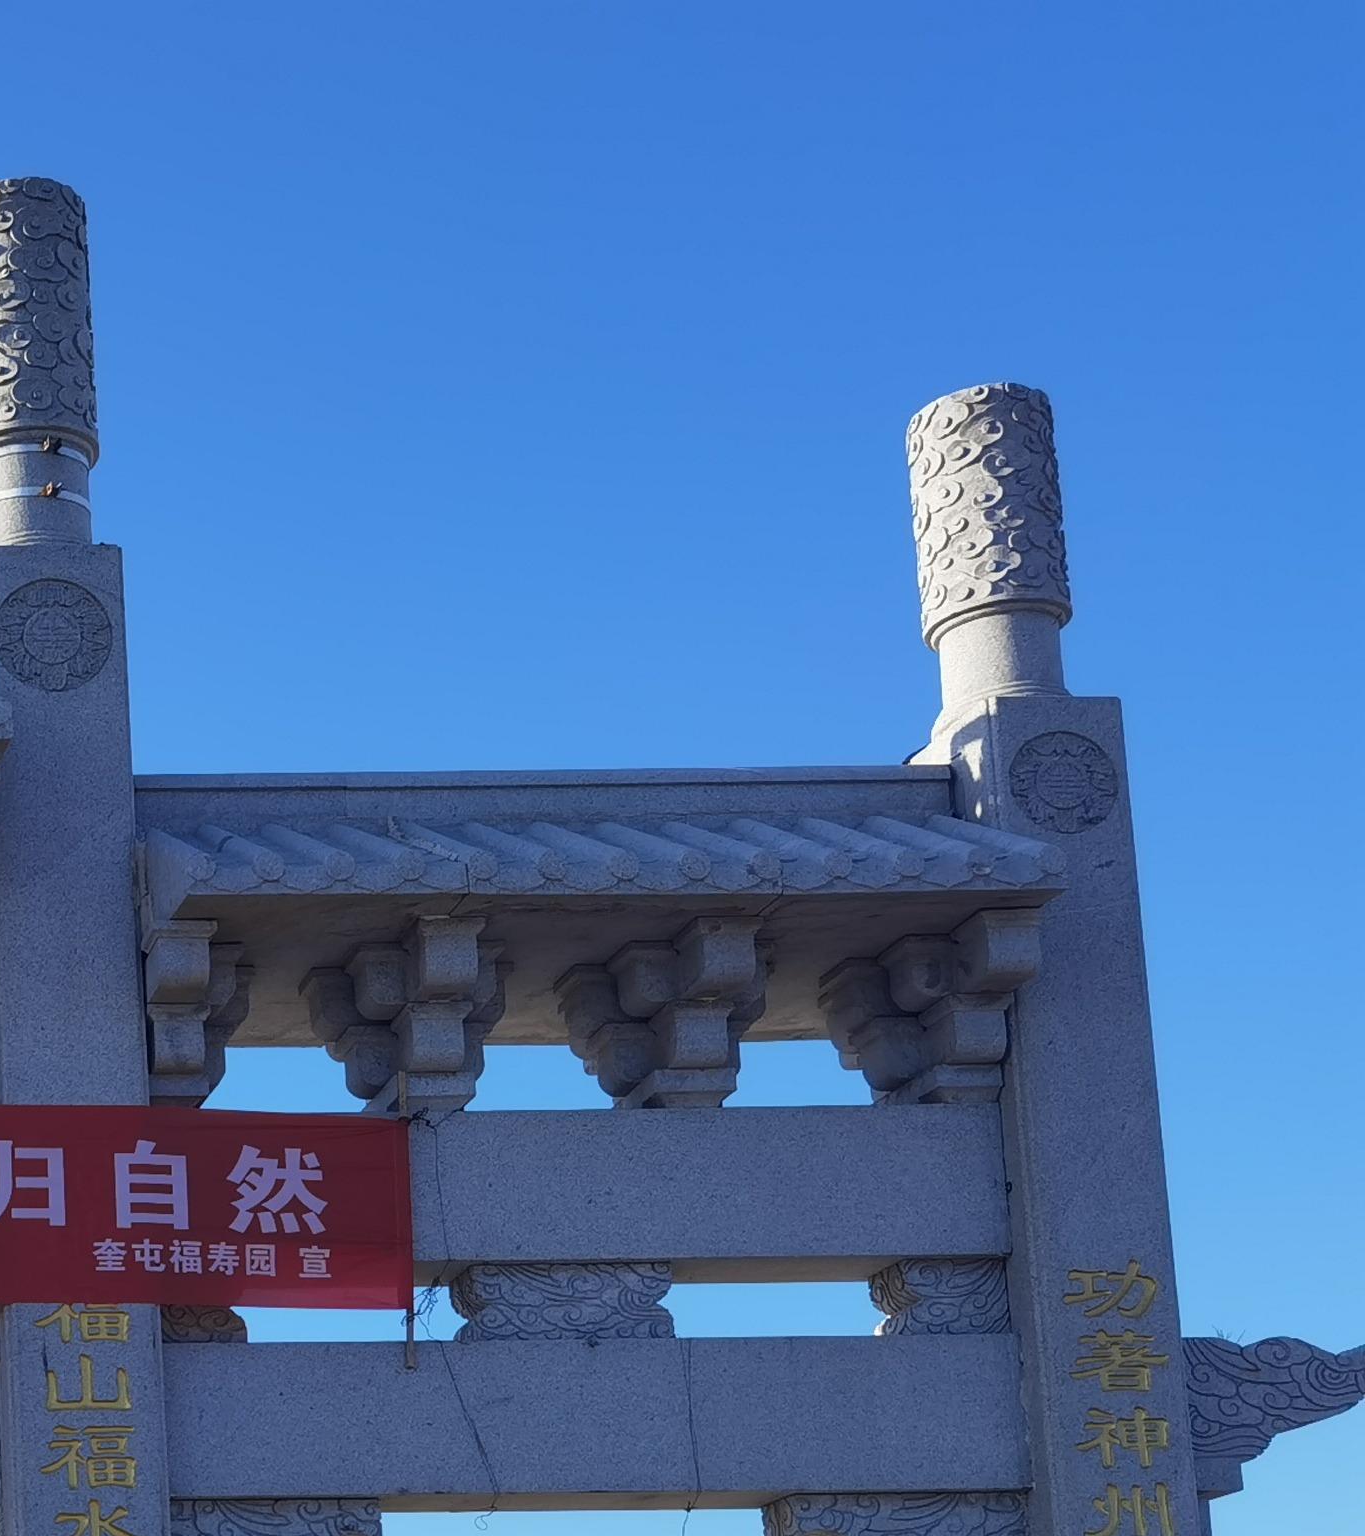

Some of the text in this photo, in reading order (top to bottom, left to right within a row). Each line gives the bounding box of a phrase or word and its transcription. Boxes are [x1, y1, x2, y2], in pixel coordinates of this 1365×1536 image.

[92, 1238, 332, 1279] 奎屯福寿园 宣
